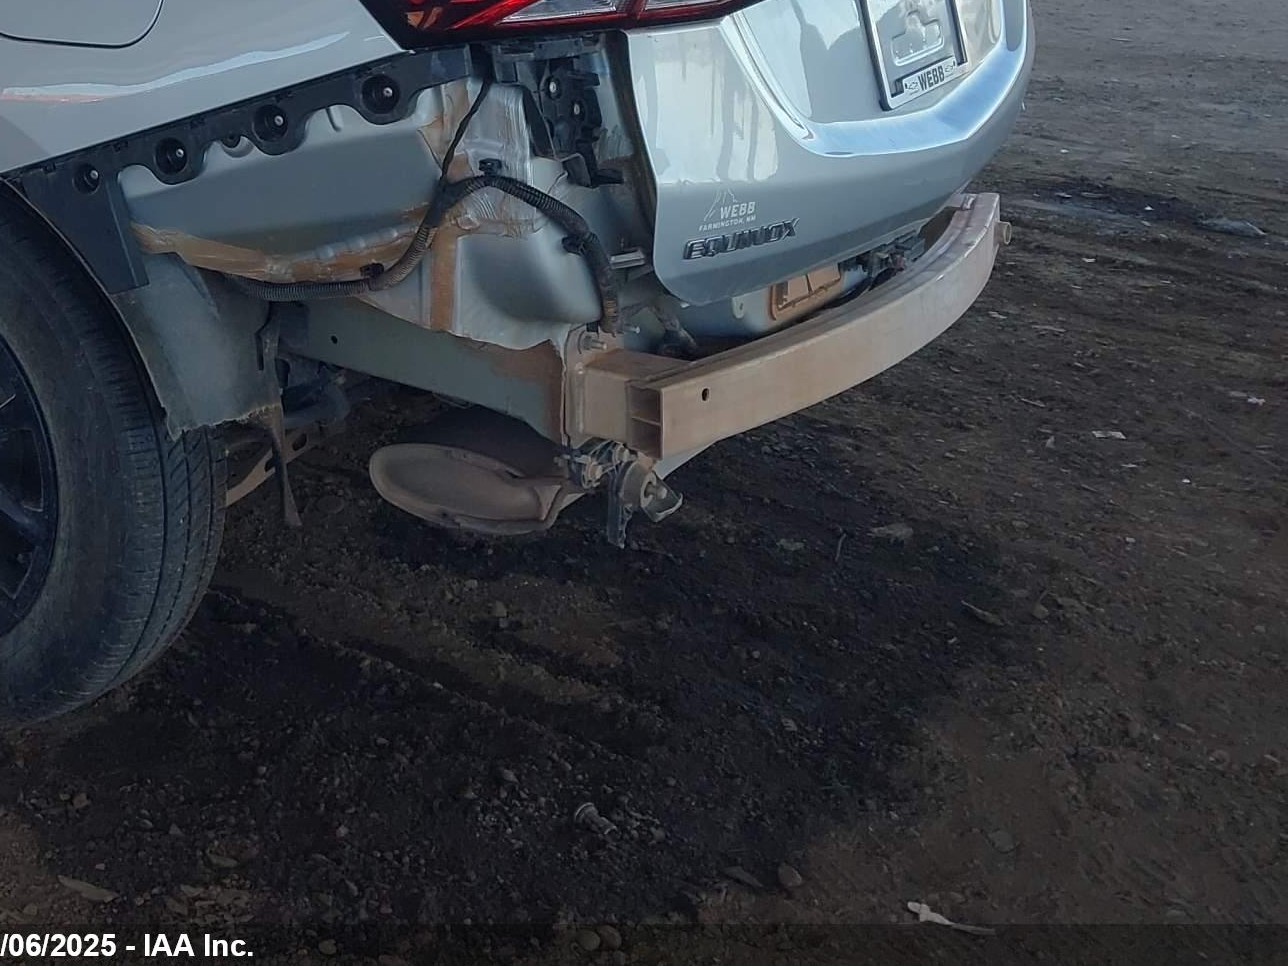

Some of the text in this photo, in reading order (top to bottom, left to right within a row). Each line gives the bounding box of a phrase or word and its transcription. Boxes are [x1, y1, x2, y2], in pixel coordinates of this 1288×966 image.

[917, 65, 945, 91] WEBB
[720, 201, 756, 219] WEBB
[682, 217, 800, 260] EQUINOX
